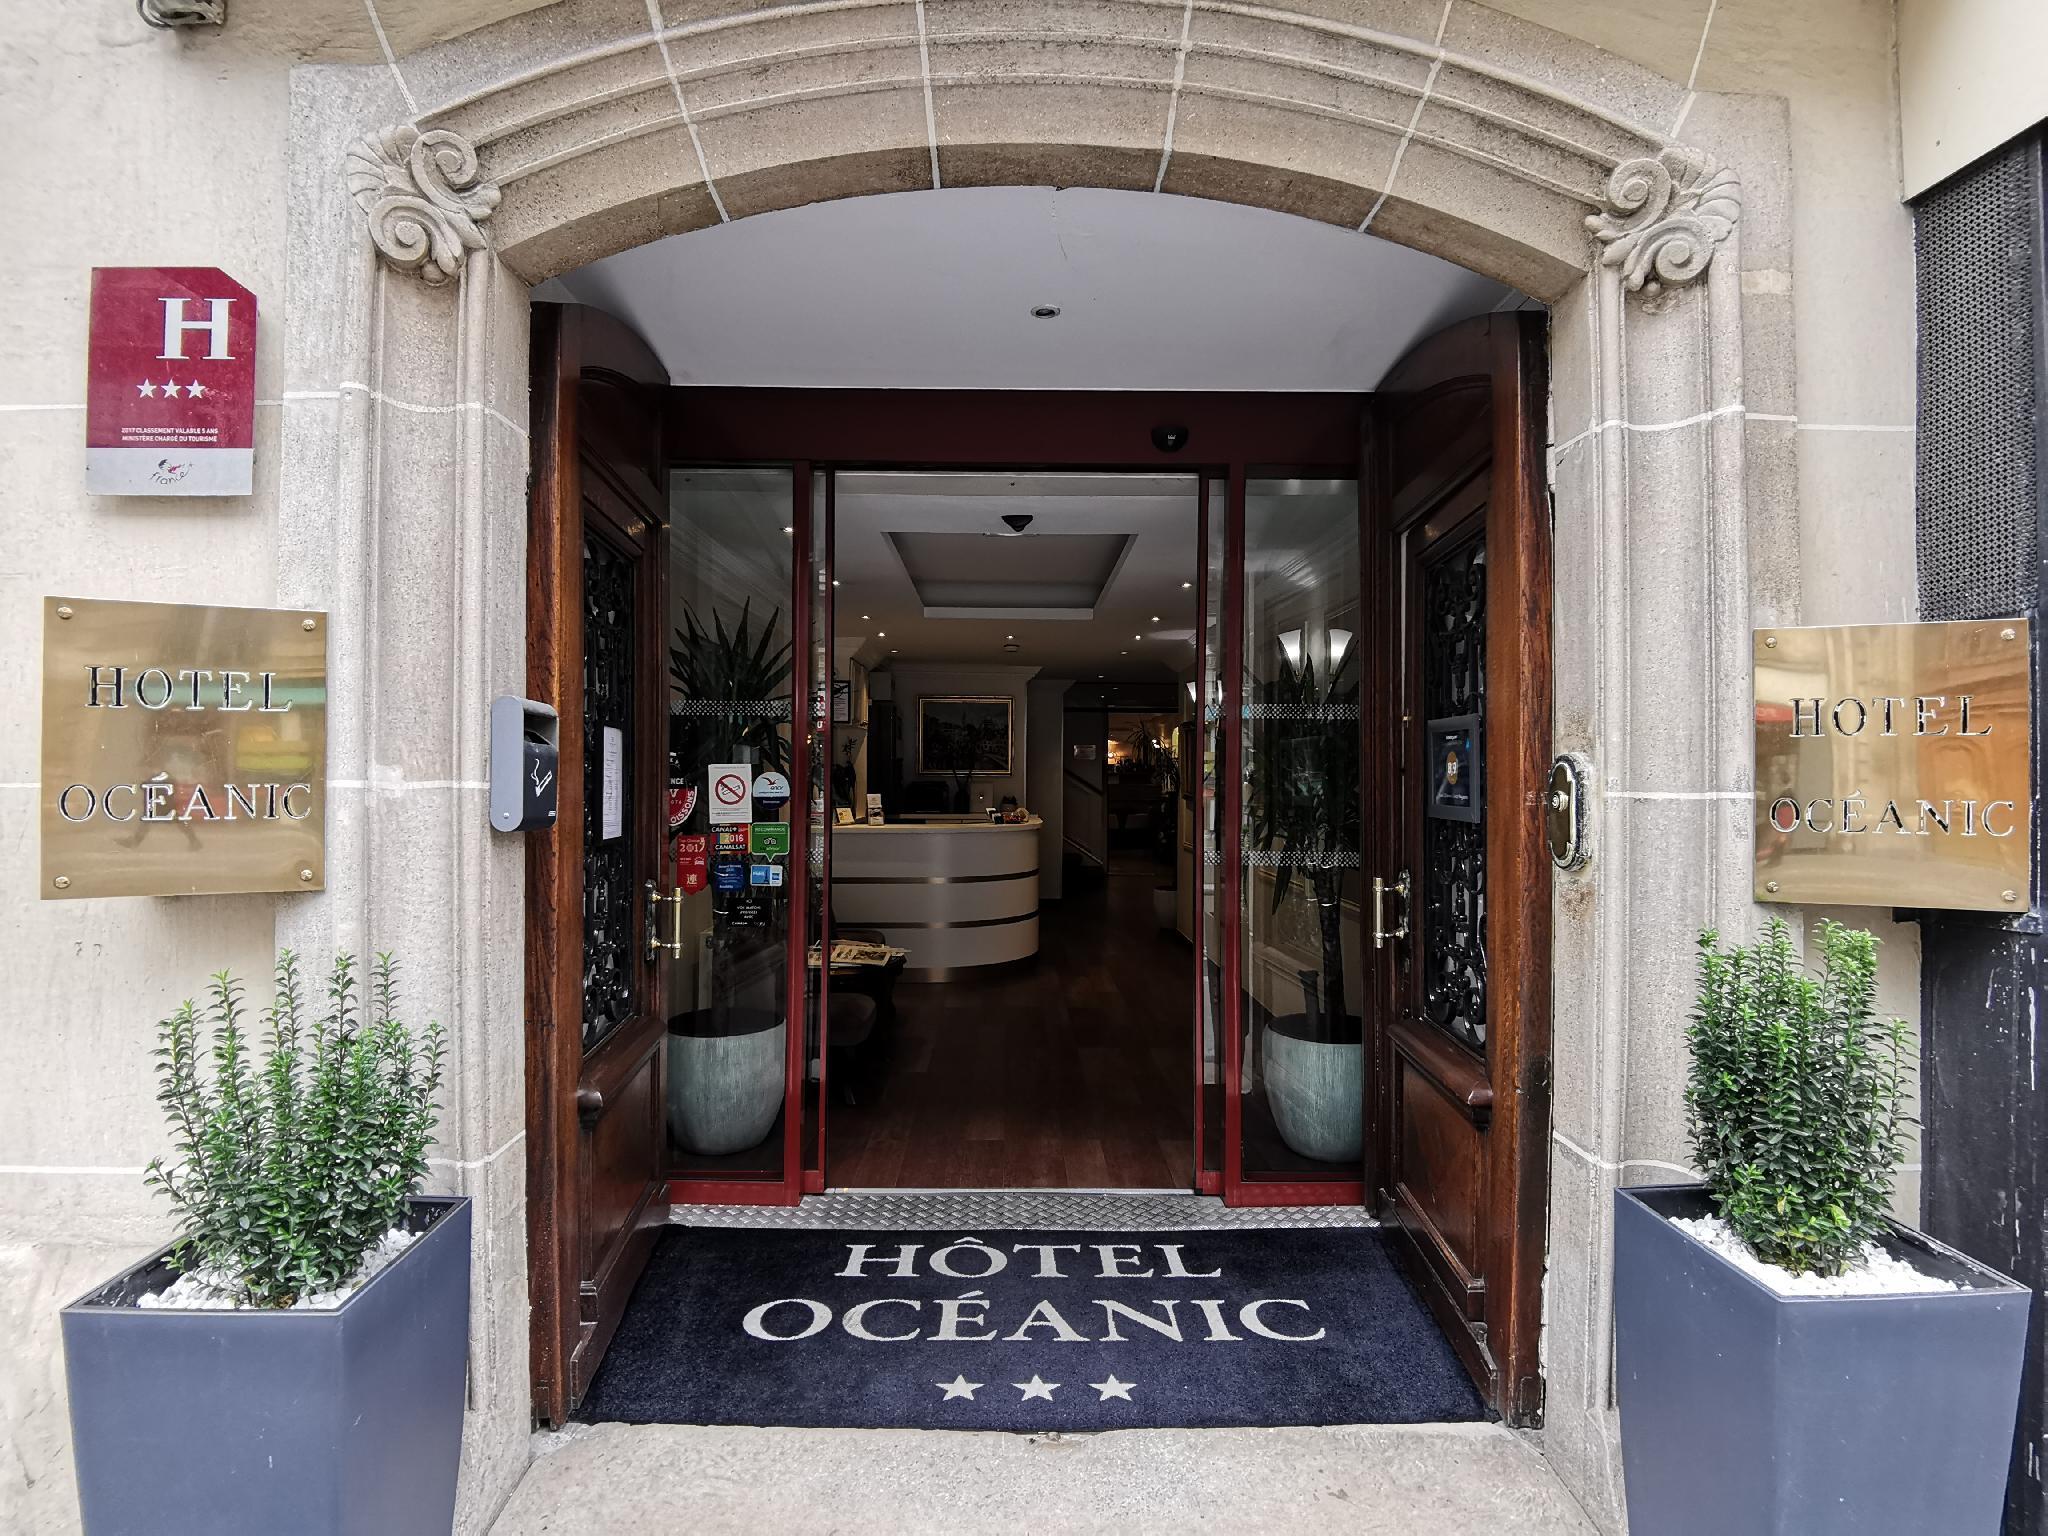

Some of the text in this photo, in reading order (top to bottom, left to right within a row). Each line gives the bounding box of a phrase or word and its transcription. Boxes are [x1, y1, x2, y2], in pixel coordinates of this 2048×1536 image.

[156, 297, 237, 360] H
[154, 434, 178, 442] CHARGÉ
[84, 664, 293, 712] HOTEL
[1788, 695, 1993, 737] HOTEL
[58, 771, 312, 822] OCÉANIC
[670, 790, 695, 824] OISSONS
[1769, 789, 2015, 838] OCÉANIC
[835, 1236, 1222, 1278] HÔTEL
[742, 1290, 1326, 1342] OCÉANIC
